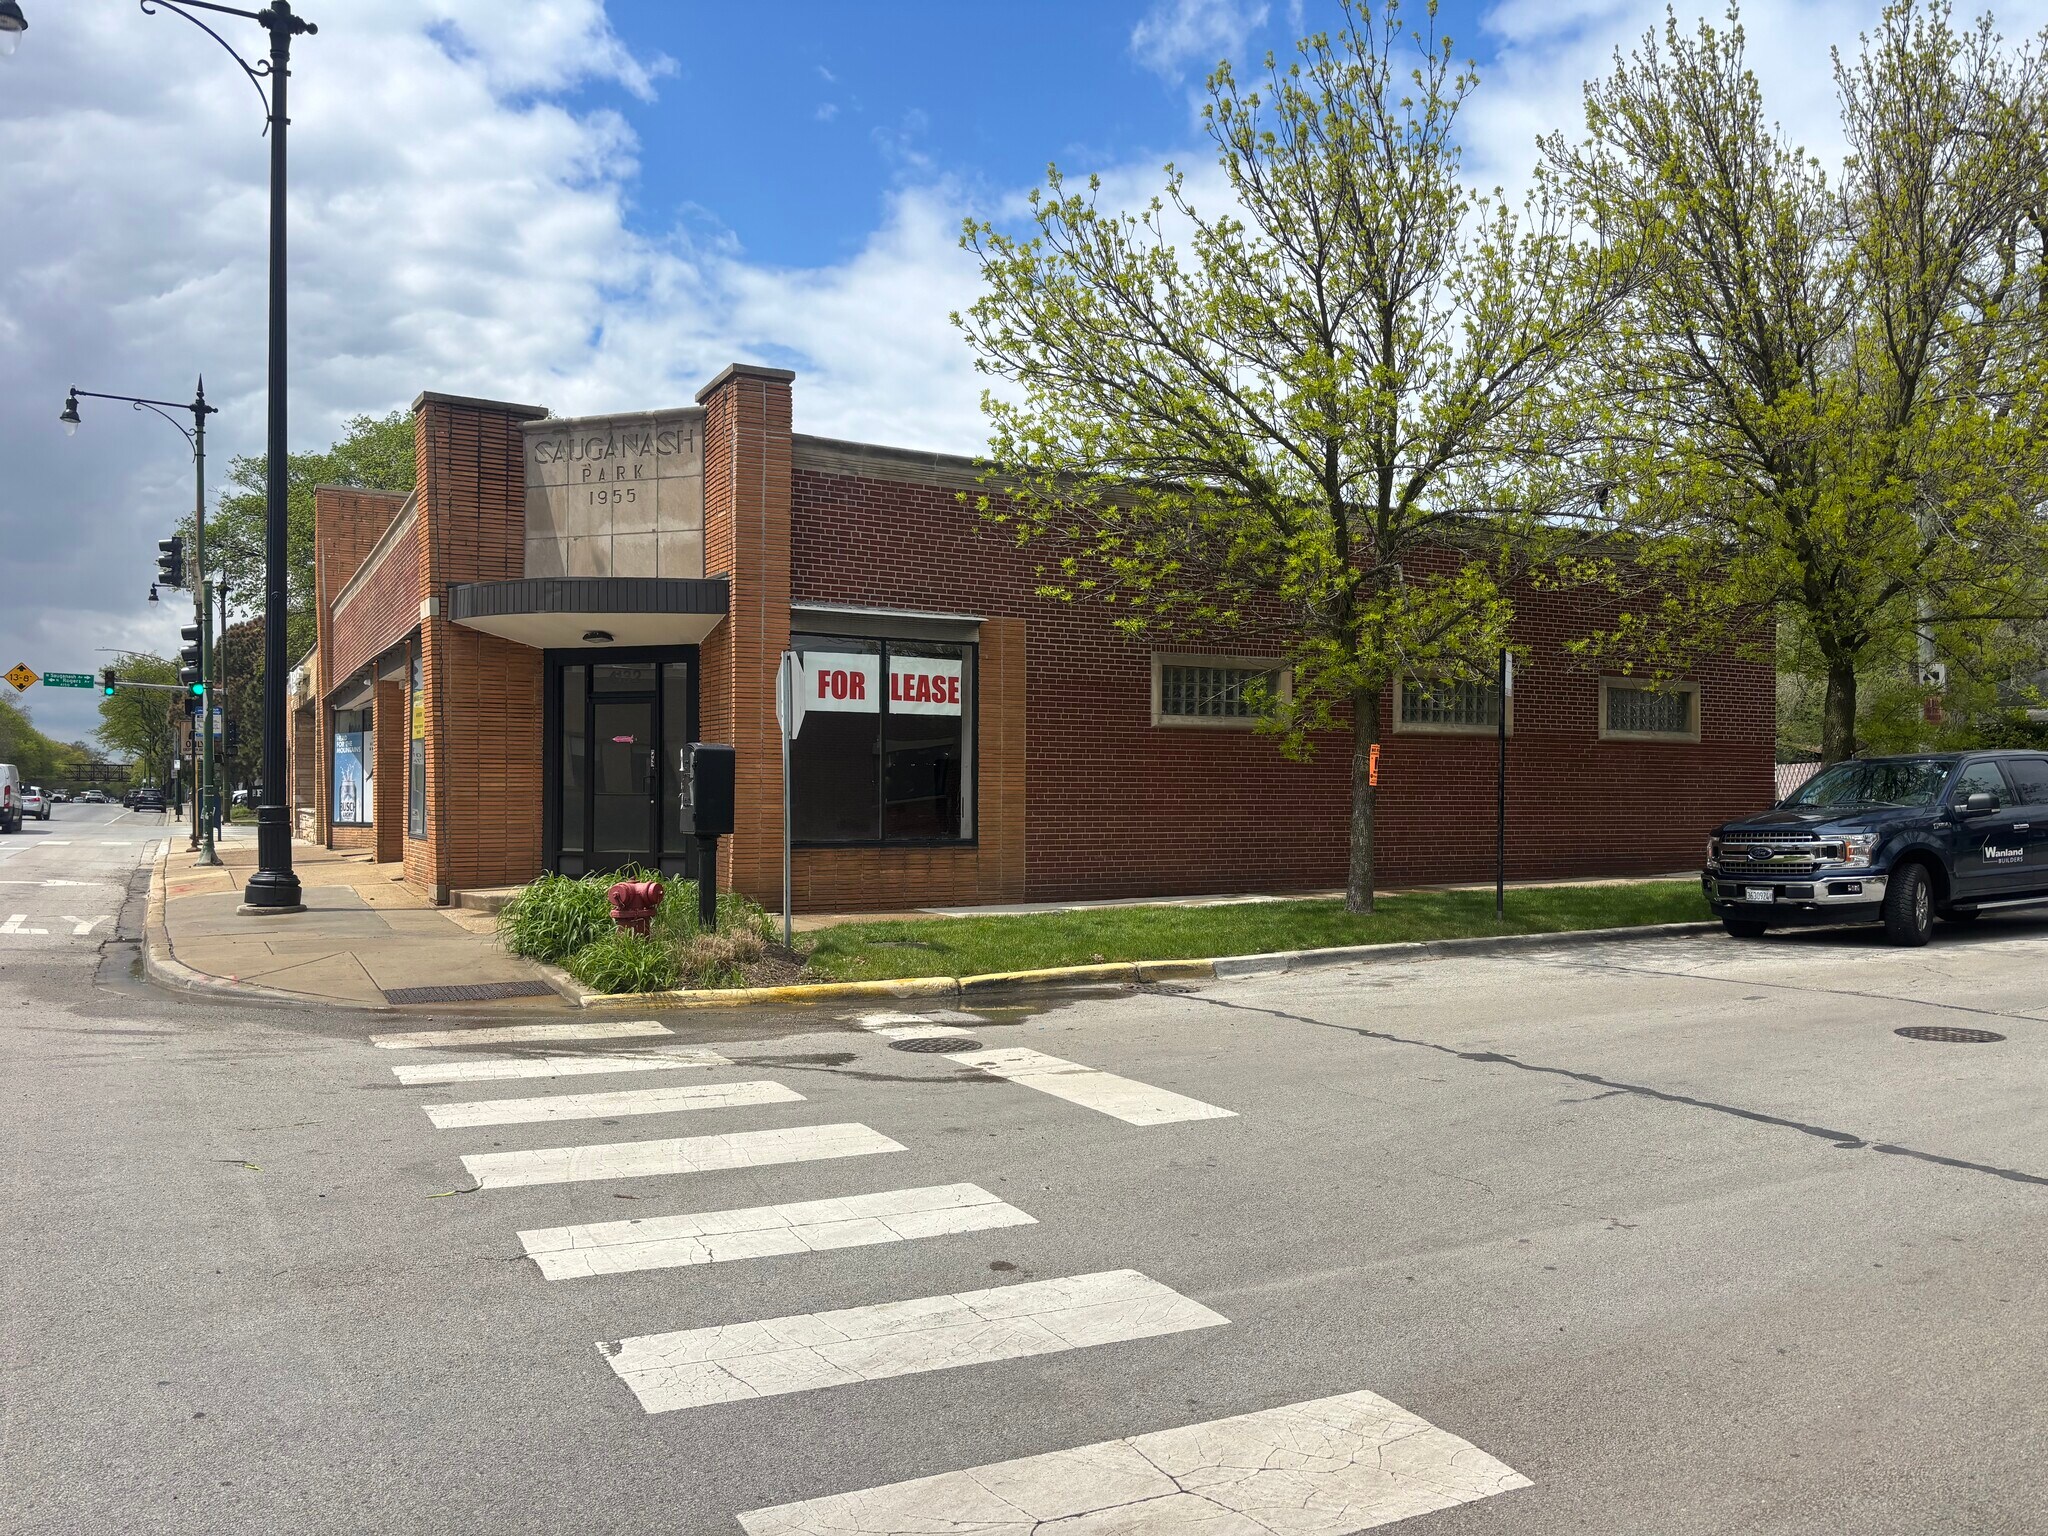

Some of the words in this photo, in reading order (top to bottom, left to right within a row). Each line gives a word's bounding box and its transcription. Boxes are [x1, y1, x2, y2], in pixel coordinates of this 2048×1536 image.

[534, 429, 693, 464] SAUGANASH
[582, 464, 643, 482] PARK
[589, 489, 636, 505] 1955
[818, 670, 865, 700] FOR
[891, 673, 959, 704] LEASE
[185, 740, 204, 748] OL
[1985, 846, 2023, 858] Wanland
